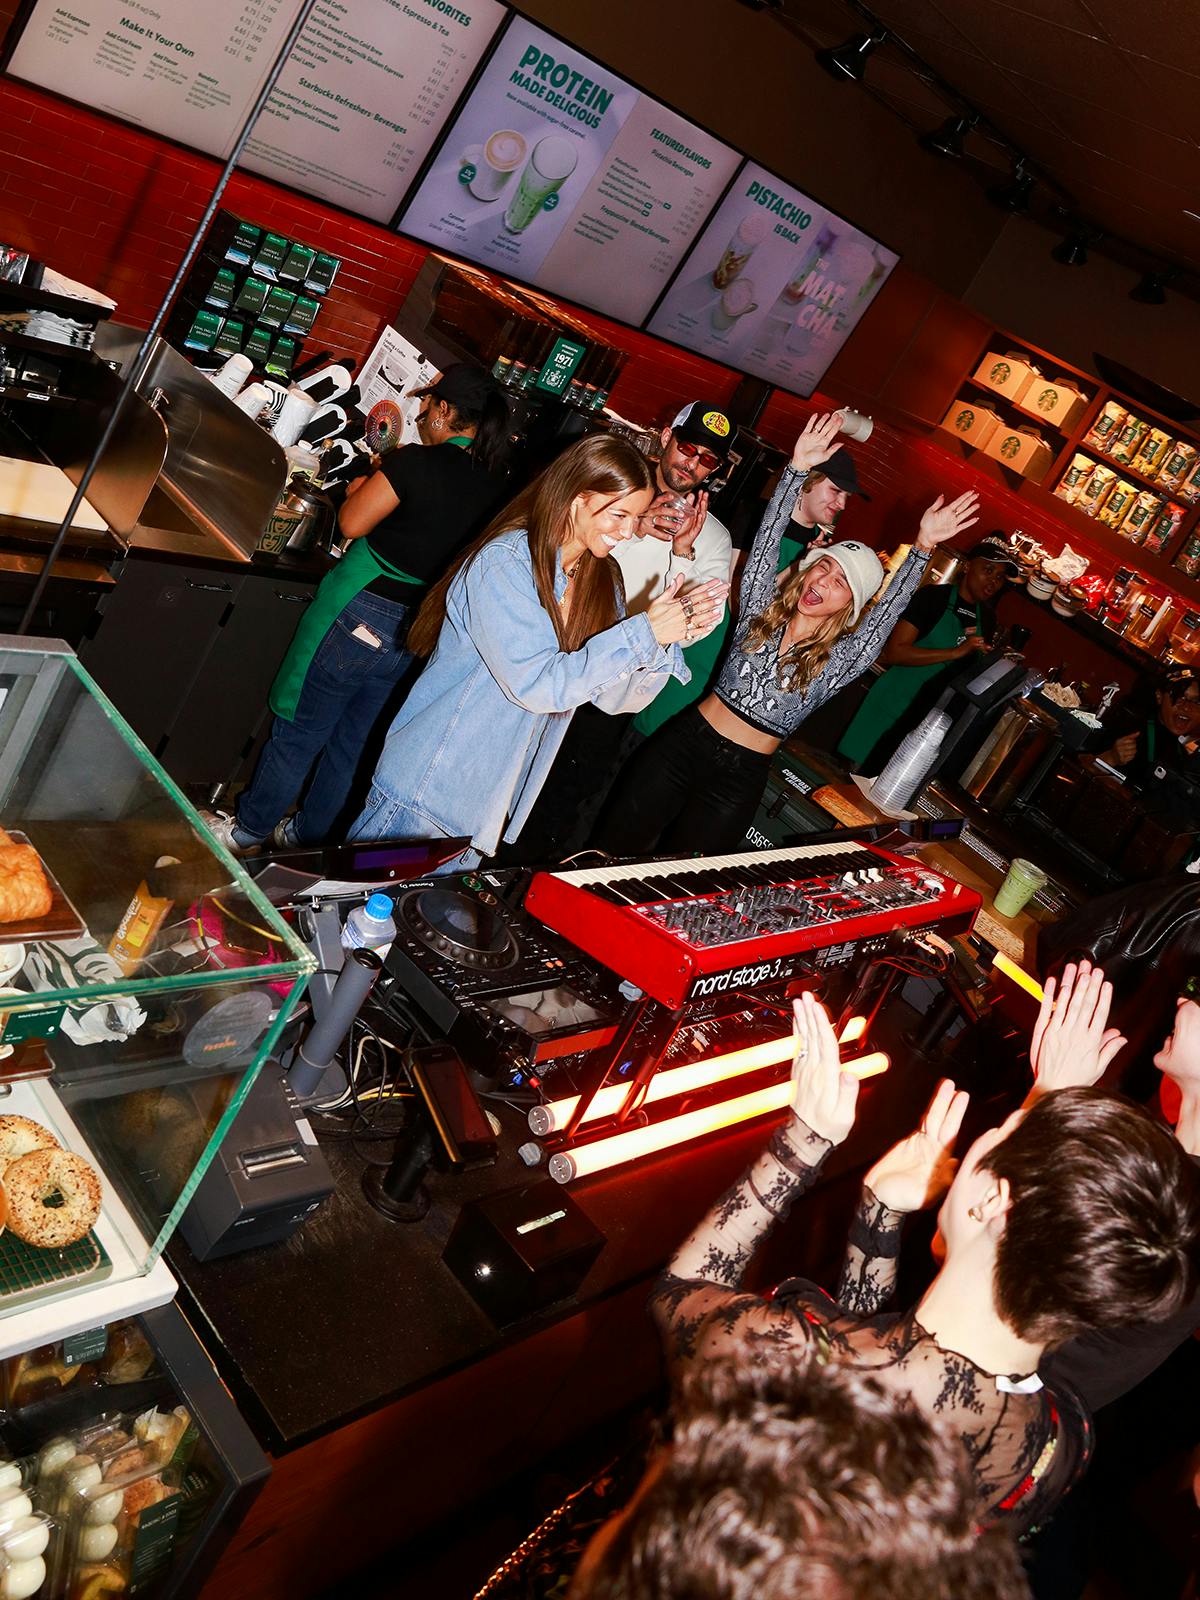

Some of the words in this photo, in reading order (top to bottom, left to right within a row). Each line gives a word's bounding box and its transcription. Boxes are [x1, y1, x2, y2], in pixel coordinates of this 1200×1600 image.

[56, 7, 66, 16] Add
[402, 5, 433, 27] Espresso
[431, 21, 439, 29] &
[438, 24, 450, 37] Tea
[423, 0, 472, 27] AVORITES
[105, 30, 116, 38] Add
[120, 16, 144, 34] Make
[145, 28, 154, 38] It
[154, 33, 173, 47] Your
[175, 42, 194, 56] Own
[309, 15, 327, 27] Vanilla
[327, 24, 343, 35] Sweet
[342, 32, 359, 43] Cream
[359, 40, 370, 49] Cold
[289, 53, 302, 62] Chai
[302, 59, 316, 68] Latte
[295, 43, 314, 56] Matcha
[314, 52, 328, 62] Latte
[519, 45, 613, 112] PROTEIN
[268, 96, 285, 108] Mango
[273, 86, 301, 103] Strawberry
[313, 105, 337, 119] Lemonade
[299, 77, 334, 98] Starbucks
[335, 94, 371, 116] Refreshers
[374, 114, 407, 134] Beverages
[509, 70, 546, 97] MADE
[545, 90, 600, 127] DELICIOUS
[650, 128, 684, 152] FEATURED
[683, 148, 711, 168] FLAVORS
[651, 149, 672, 164] Pistachio
[671, 161, 694, 177] Beverages
[746, 182, 812, 229] PISTACHIO
[773, 223, 783, 234] IS
[780, 227, 801, 244] BACK
[799, 271, 845, 307] MAT
[796, 304, 840, 338] CHA
[554, 352, 574, 367] 1971
[691, 971, 732, 998] nord
[730, 965, 771, 988] stage
[769, 958, 782, 978] 3
